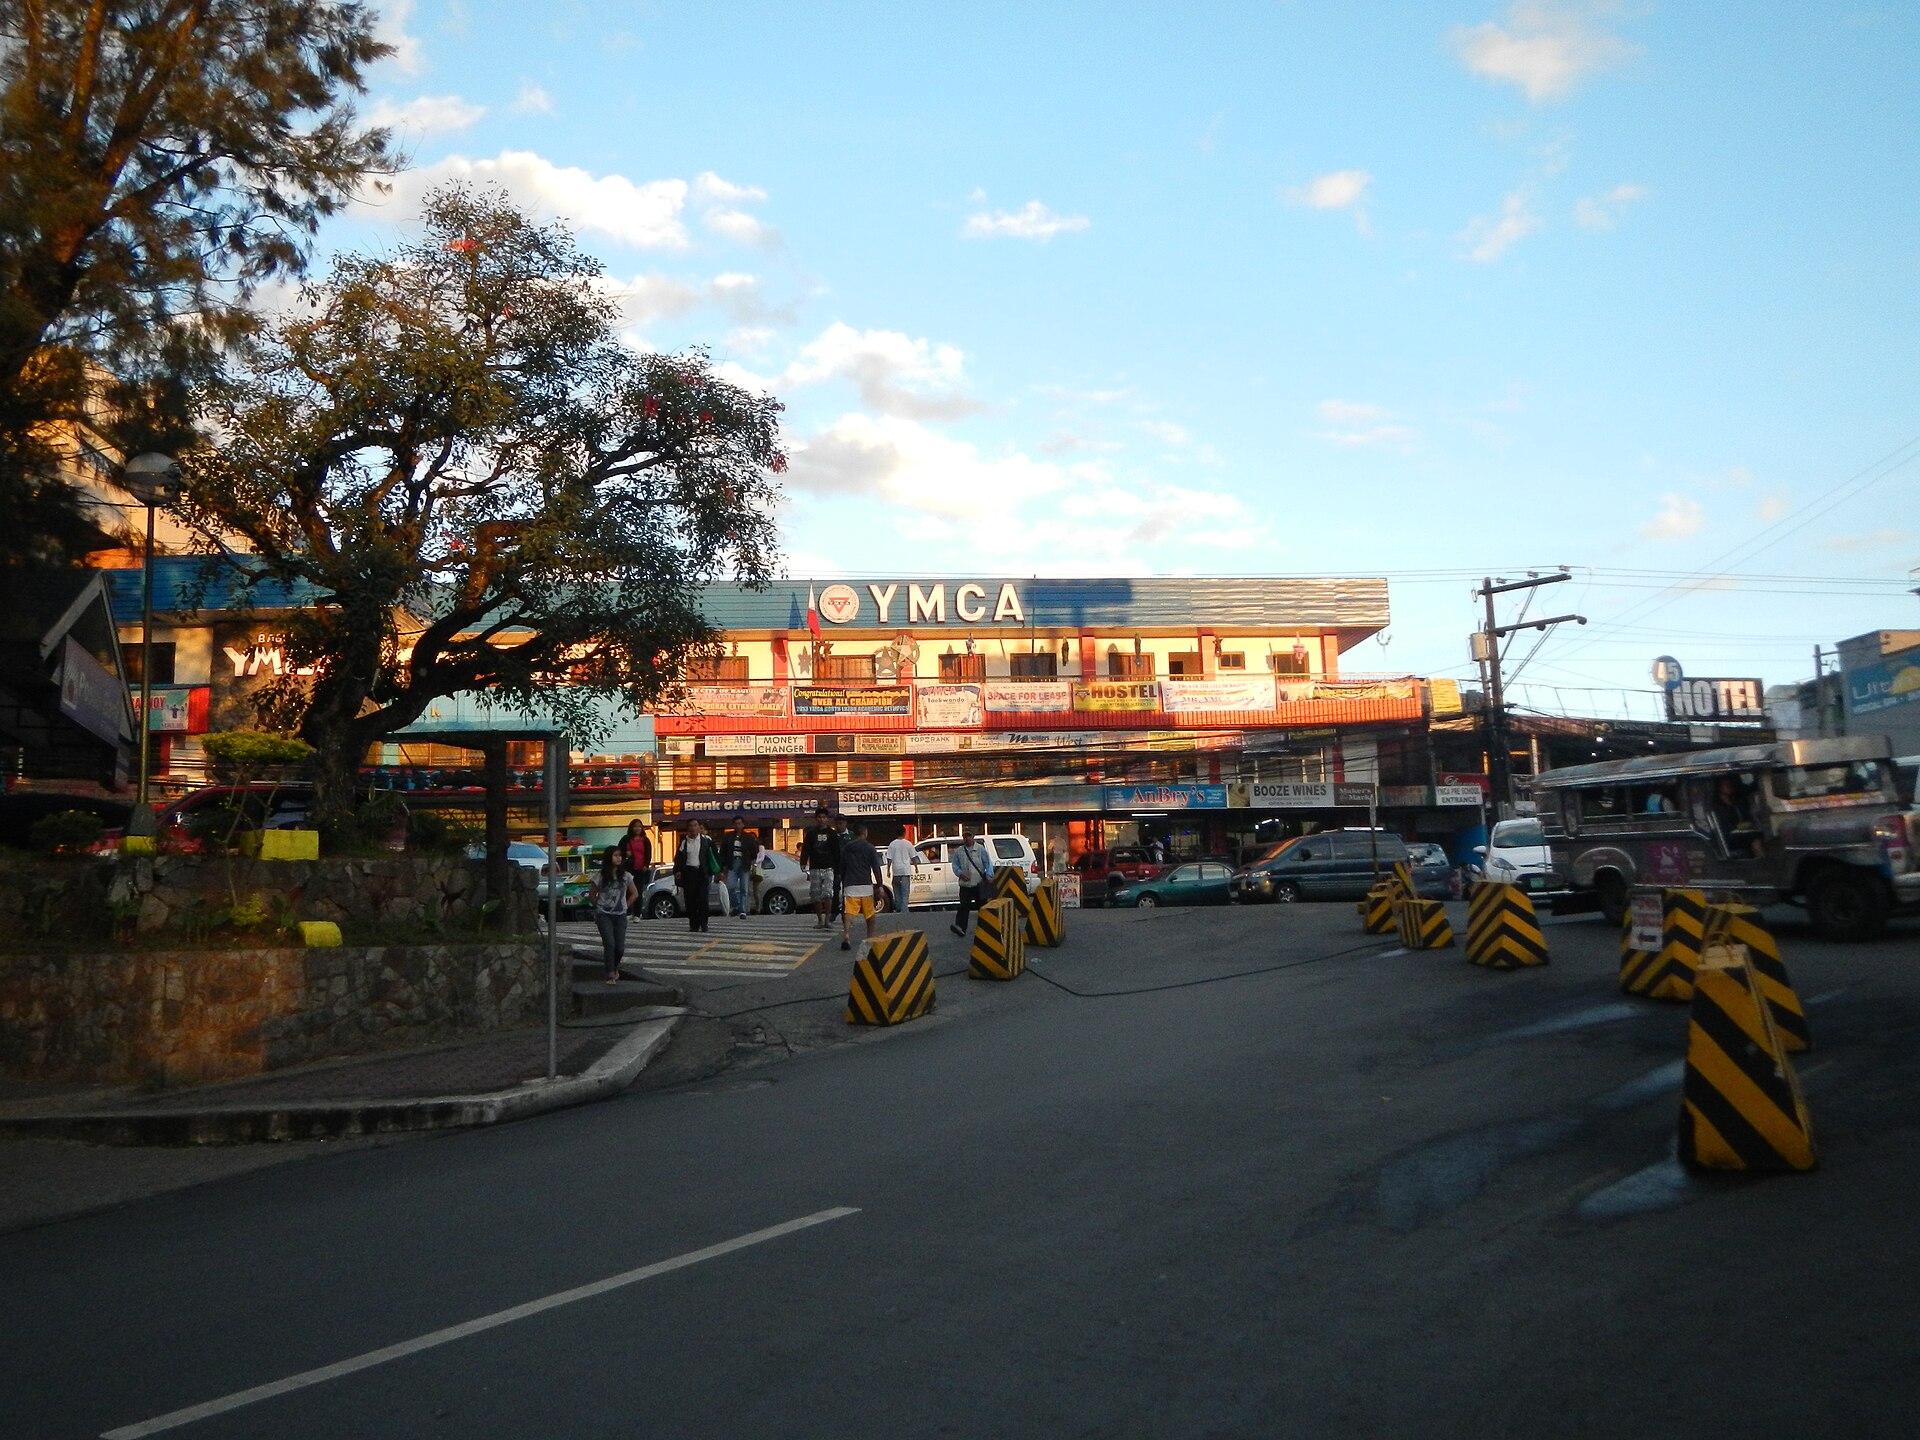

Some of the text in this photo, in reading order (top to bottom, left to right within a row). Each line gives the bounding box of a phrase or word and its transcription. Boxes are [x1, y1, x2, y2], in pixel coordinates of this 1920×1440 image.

[867, 583, 1025, 623] YMCA
[926, 687, 957, 696] YMCA
[988, 691, 1067, 700] SPACE FOR LEASE
[1091, 685, 1157, 698] HOSTEL
[812, 698, 893, 706] OVER ALL CHAMPION
[1673, 681, 1762, 716] HOTEL
[763, 736, 798, 744] MONEY
[757, 745, 804, 754] CHANGER
[843, 791, 911, 802] SECOND FLOOR
[1130, 786, 1205, 806] AnBry's
[1254, 785, 1327, 797] BOOZE WINES
[684, 799, 819, 811] Bank of Commerce
[857, 803, 898, 812] ENTRANCE
